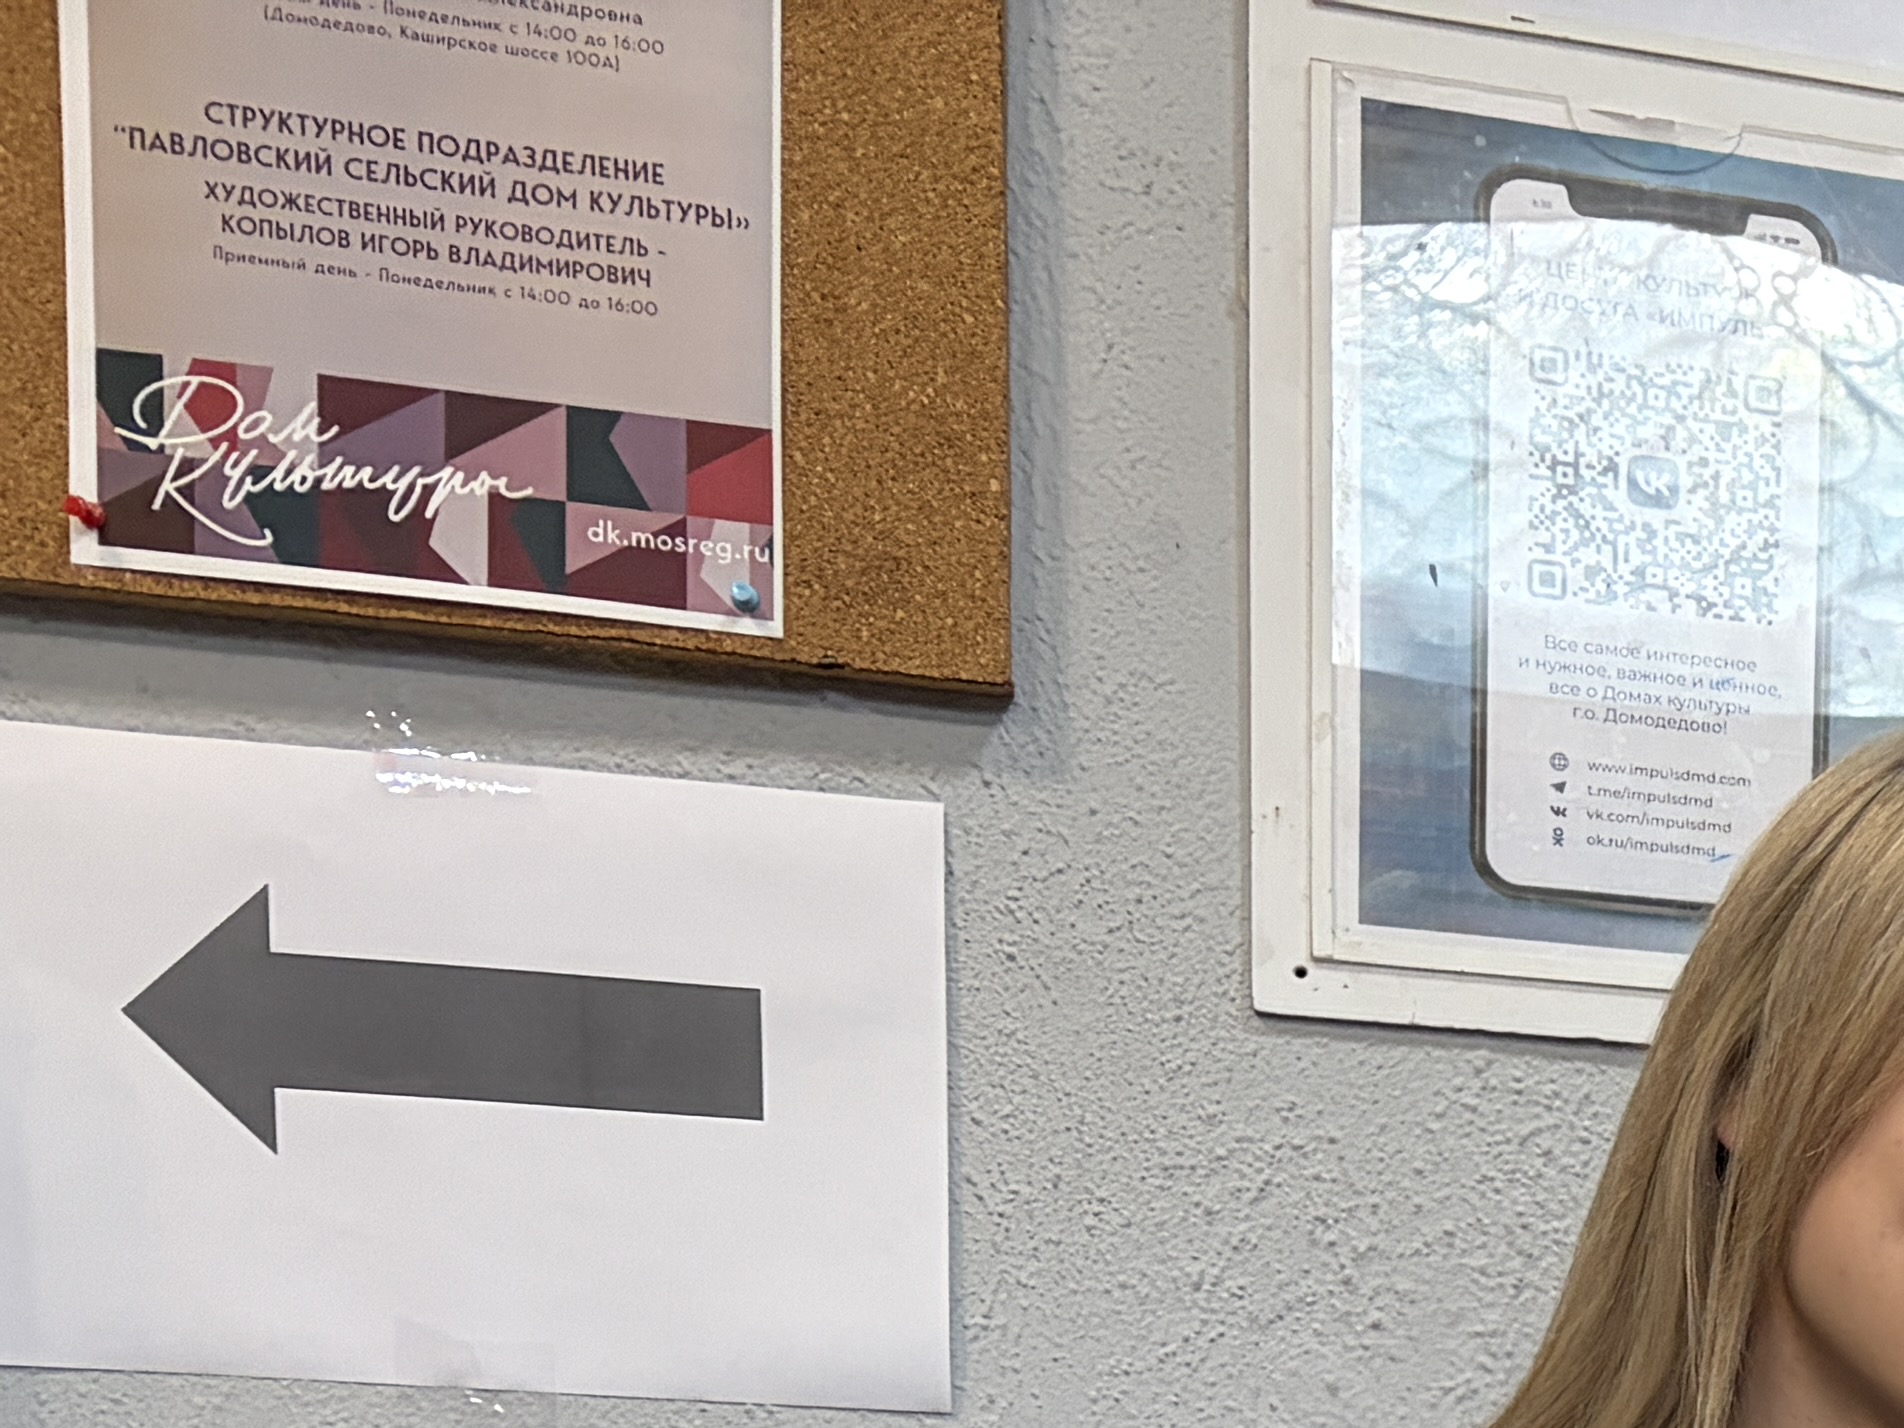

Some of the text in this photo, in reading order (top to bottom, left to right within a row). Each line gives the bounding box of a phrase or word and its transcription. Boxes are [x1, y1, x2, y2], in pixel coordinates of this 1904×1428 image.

[204, 100, 665, 185] СТРУКТУРНОЕ ПОДРАЗДЕЛЕНИЕ
[203, 180, 649, 257] ХУДОЖЕСТВЕННЫЙ РУКОВОДИТЕЛЬ
[344, 158, 496, 199] СЕЛЬСКИЙ
[508, 180, 577, 210] ДОМ
[590, 190, 750, 231] КУЛЬТУРЫ»
[221, 214, 651, 288] КОПЫЛОВ ИГОРЬ ВЛАДИМИРОВИЧ
[213, 245, 658, 316] Приемный день Понедельник с 14:00 до 16:00
[113, 373, 340, 447] Дом
[150, 441, 533, 547] Культуры
[586, 517, 772, 566] dk.mosreg.ru
[1544, 634, 1757, 672] Все самое интересное
[1550, 682, 1750, 717] все о Домах культуры
[1572, 706, 1728, 735] г.о. Домодедово!
[1587, 784, 1713, 809] t.me/impulsdmd
[1588, 760, 1751, 787] www.impulsdmd.com
[1586, 809, 1732, 834] vk.com/impulsdmd
[1586, 834, 1716, 858] ok.ru/impulsdmd
